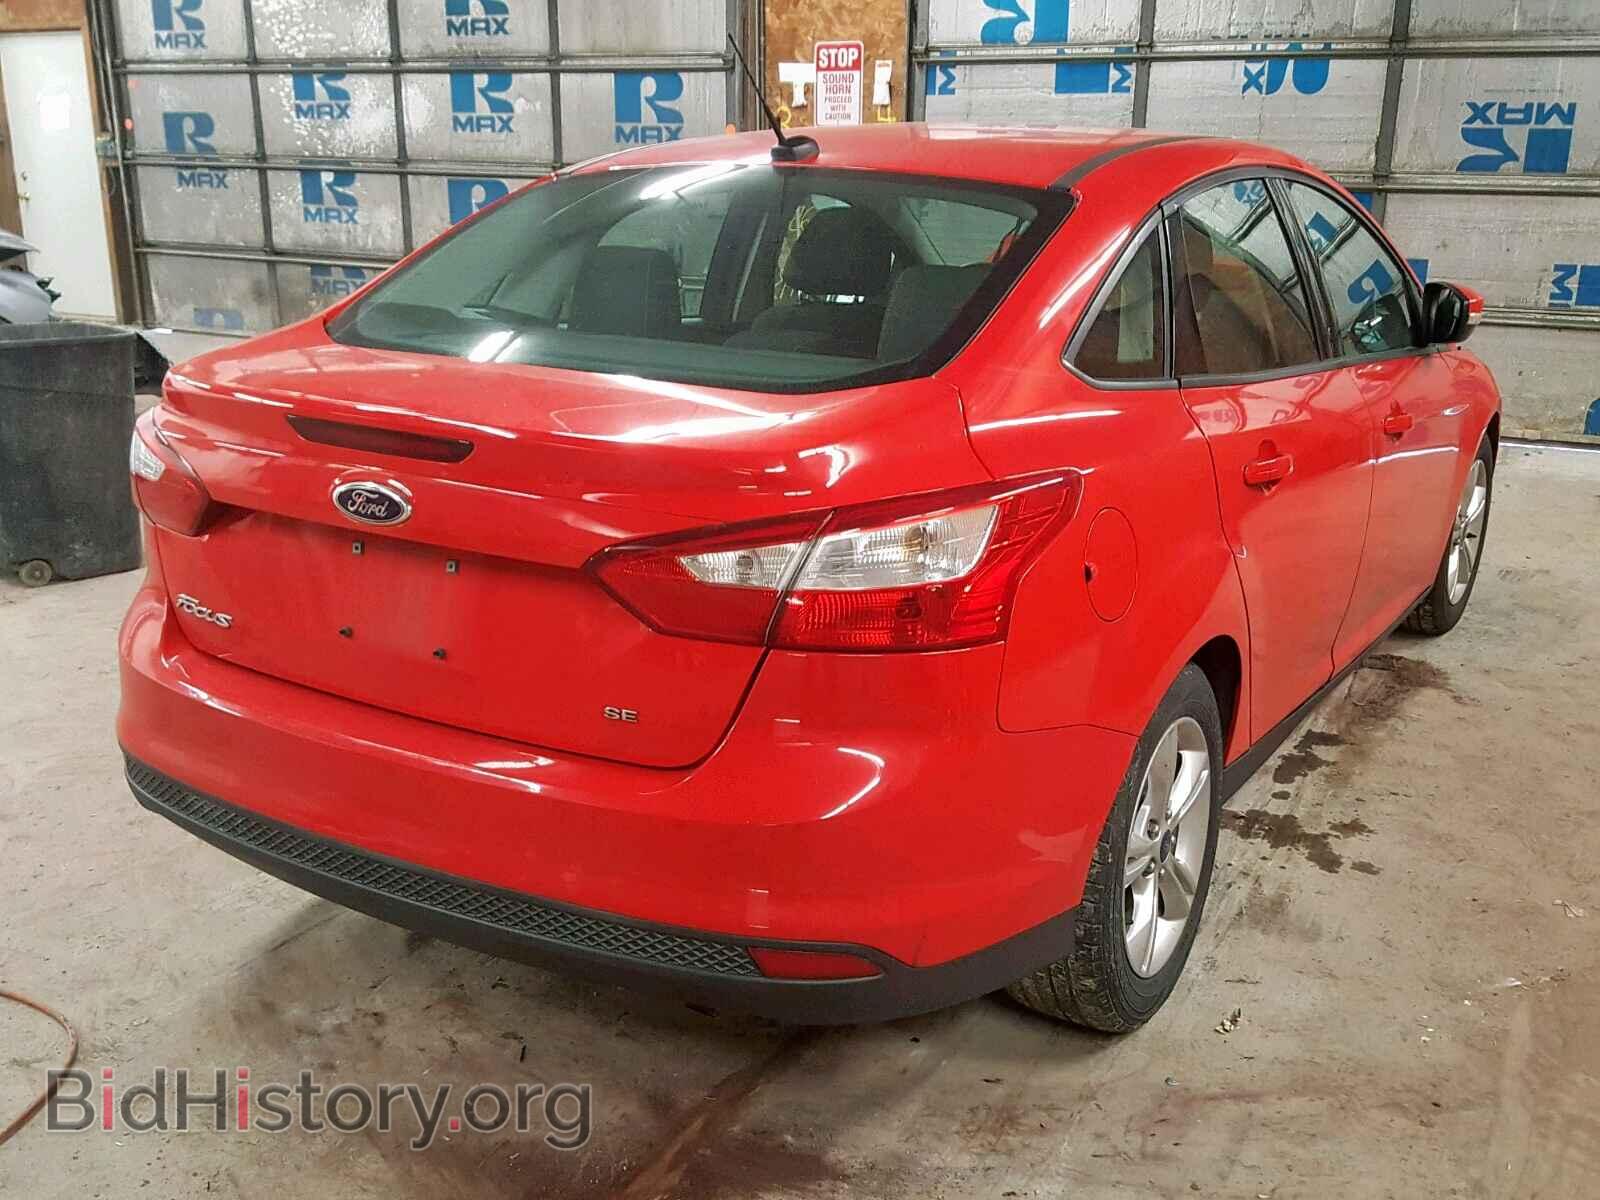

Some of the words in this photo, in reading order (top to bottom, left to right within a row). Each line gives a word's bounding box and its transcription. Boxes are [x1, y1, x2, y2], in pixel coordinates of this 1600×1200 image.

[446, 16, 511, 37] MAX
[154, 32, 208, 49] MAX
[818, 47, 859, 68] STOP
[822, 73, 855, 84] SOUND
[825, 84, 852, 95] HORN
[294, 103, 352, 120] MAX
[1461, 101, 1577, 126] MAX
[453, 115, 515, 133] MAX
[176, 171, 229, 189] MAX
[303, 206, 360, 225] MAX
[347, 489, 390, 518] Ford
[603, 706, 638, 724] SE
